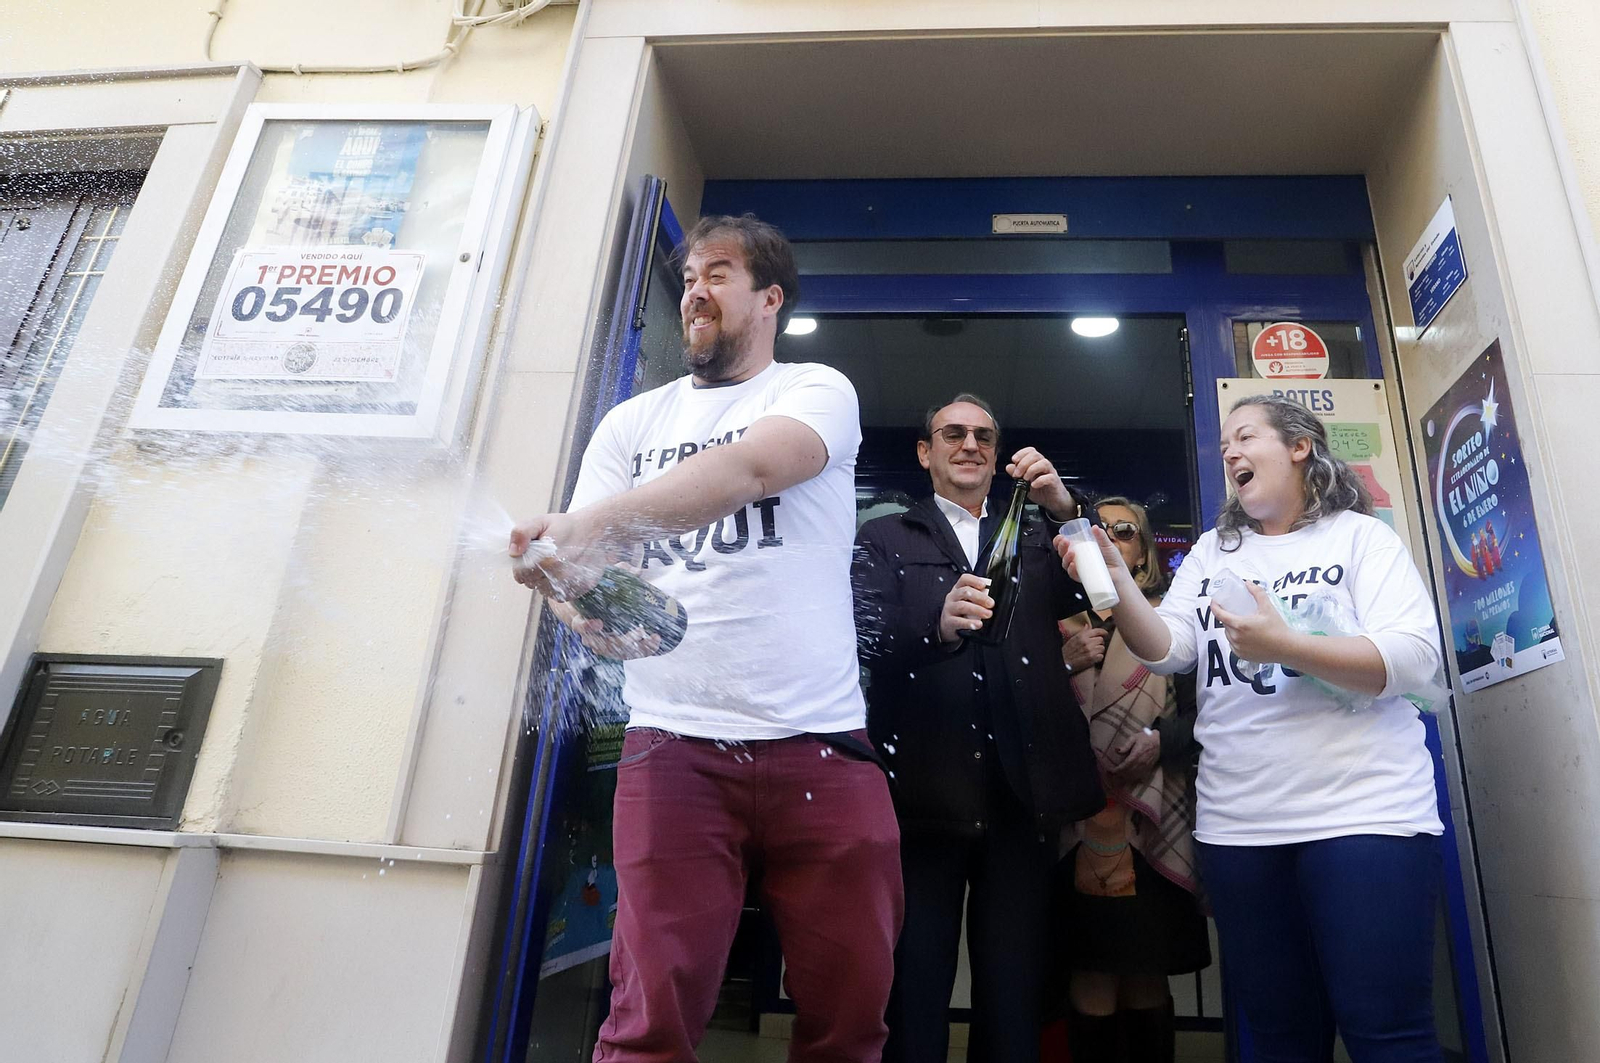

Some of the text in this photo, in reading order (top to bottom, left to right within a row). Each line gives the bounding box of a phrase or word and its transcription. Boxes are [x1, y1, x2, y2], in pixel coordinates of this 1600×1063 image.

[340, 252, 364, 260] AQUÍ
[276, 265, 397, 286] PREMIO
[231, 286, 404, 324] 05490
[1266, 329, 1308, 351] +18
[1452, 431, 1483, 469] SORTEO
[1448, 459, 1500, 516] EL NIÑO
[1467, 508, 1477, 525] DE
[1475, 493, 1498, 519] ENERO
[78, 708, 131, 726] AGUA
[50, 746, 138, 766] POTABLE
